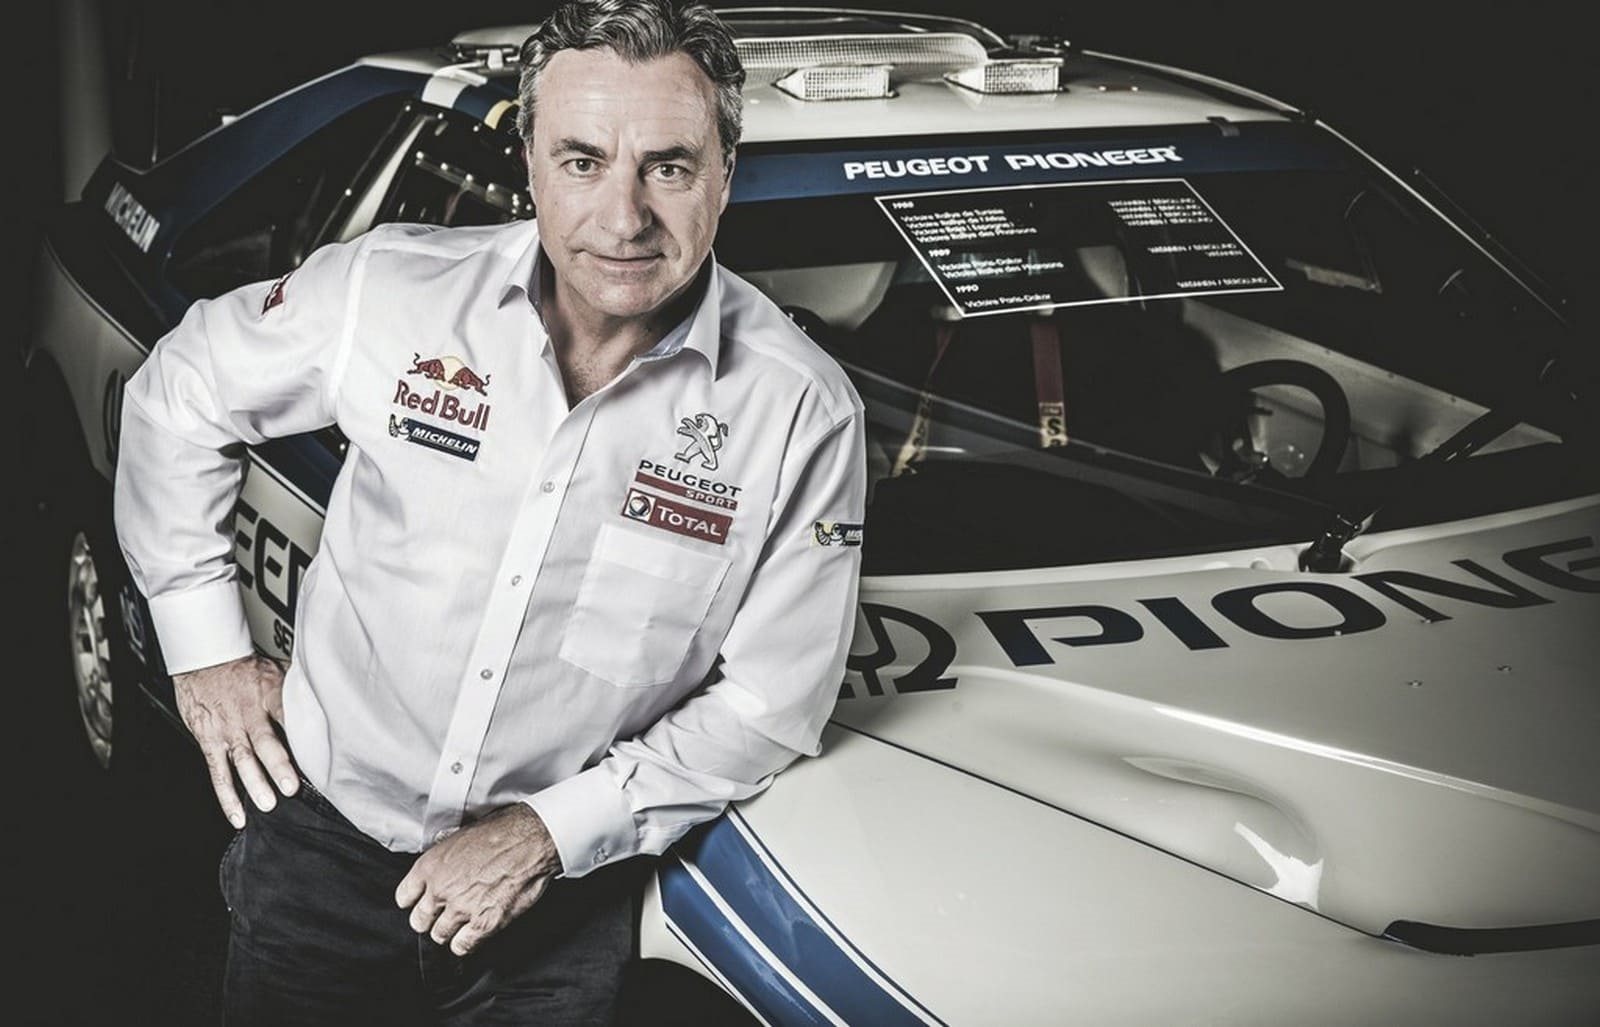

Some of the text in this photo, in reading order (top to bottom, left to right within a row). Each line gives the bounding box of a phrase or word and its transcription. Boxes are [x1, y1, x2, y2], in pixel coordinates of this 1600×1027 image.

[843, 146, 1183, 180] PEUGEOT PIONEER
[105, 182, 160, 253] MICHELIN
[955, 283, 979, 293] 1990
[393, 379, 491, 431] Red Bull
[411, 427, 478, 454] MICHELIN
[638, 459, 742, 497] PEUGEOT
[685, 488, 736, 508] SPORT
[657, 505, 722, 537] TOTAL
